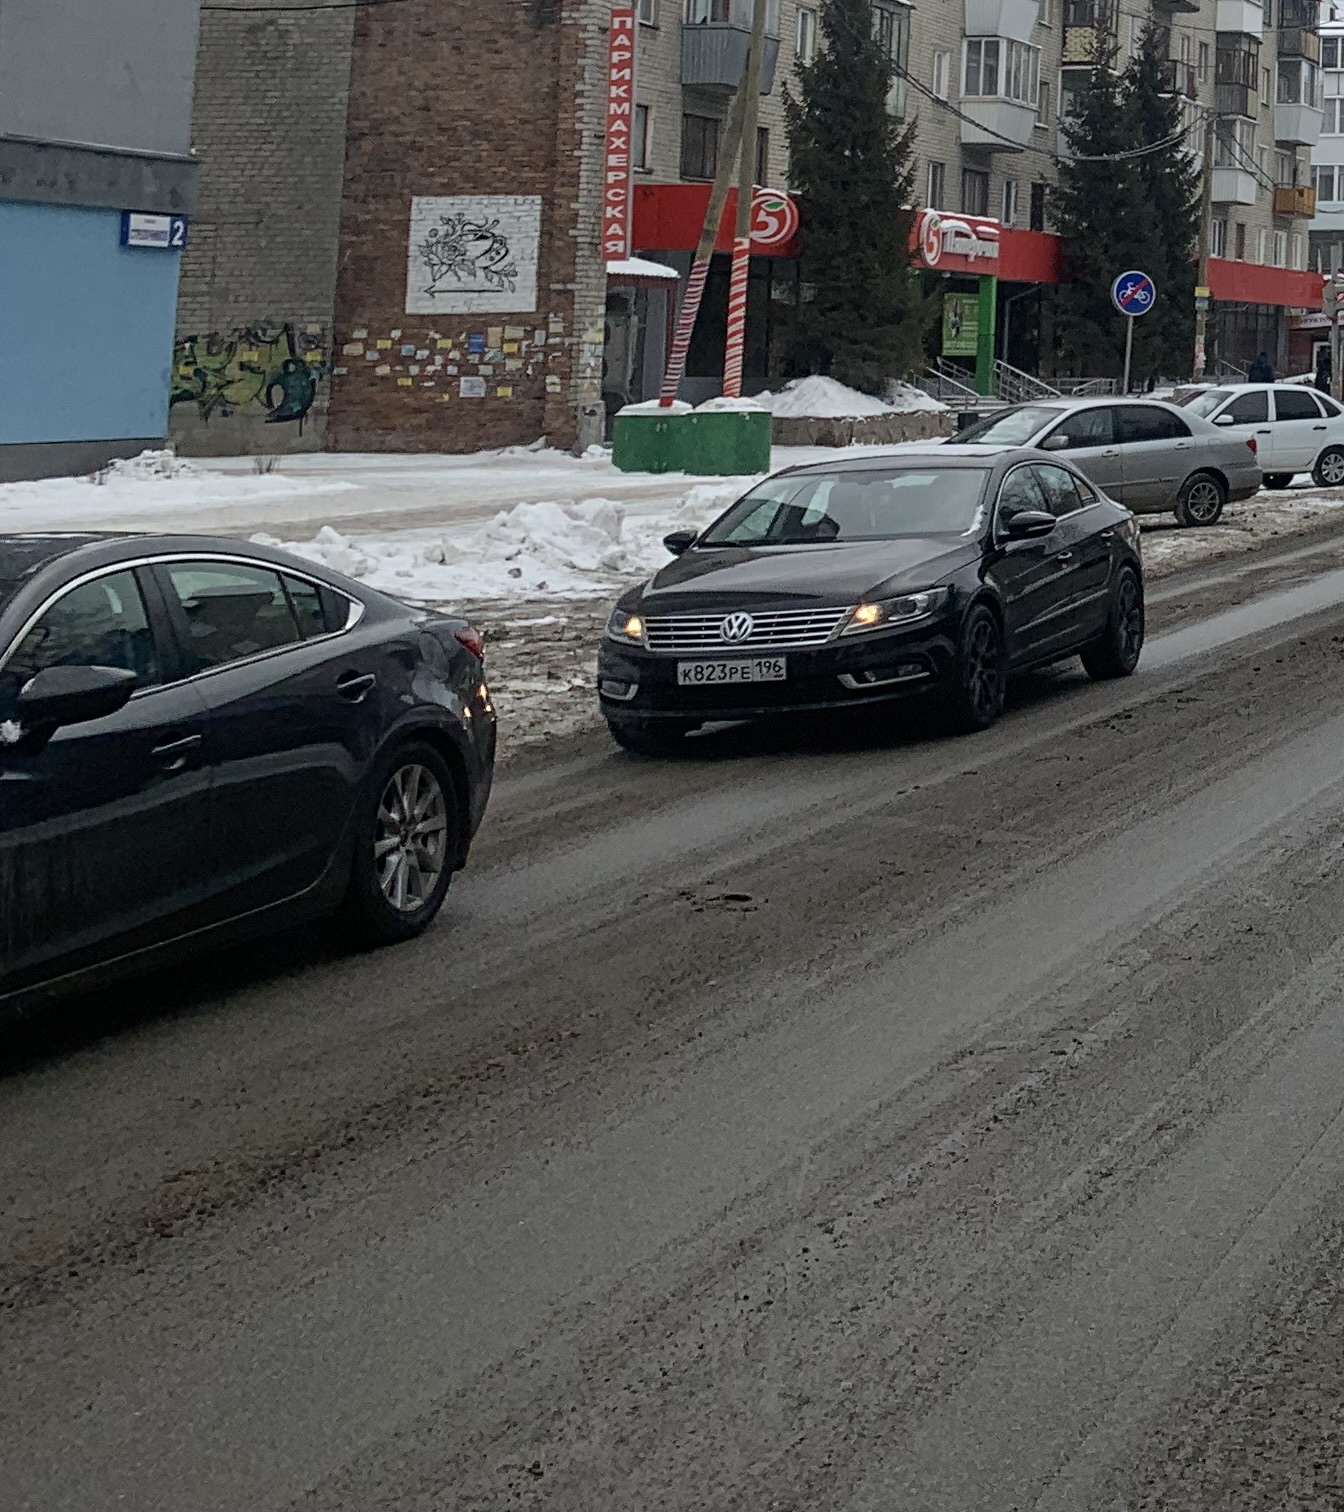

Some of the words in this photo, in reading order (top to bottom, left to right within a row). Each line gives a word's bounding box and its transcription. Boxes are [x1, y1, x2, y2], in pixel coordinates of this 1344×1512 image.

[605, 16, 633, 254] ПАРИКМАХЕРСКАЯ
[172, 221, 184, 246] 2
[755, 660, 783, 674] 196
